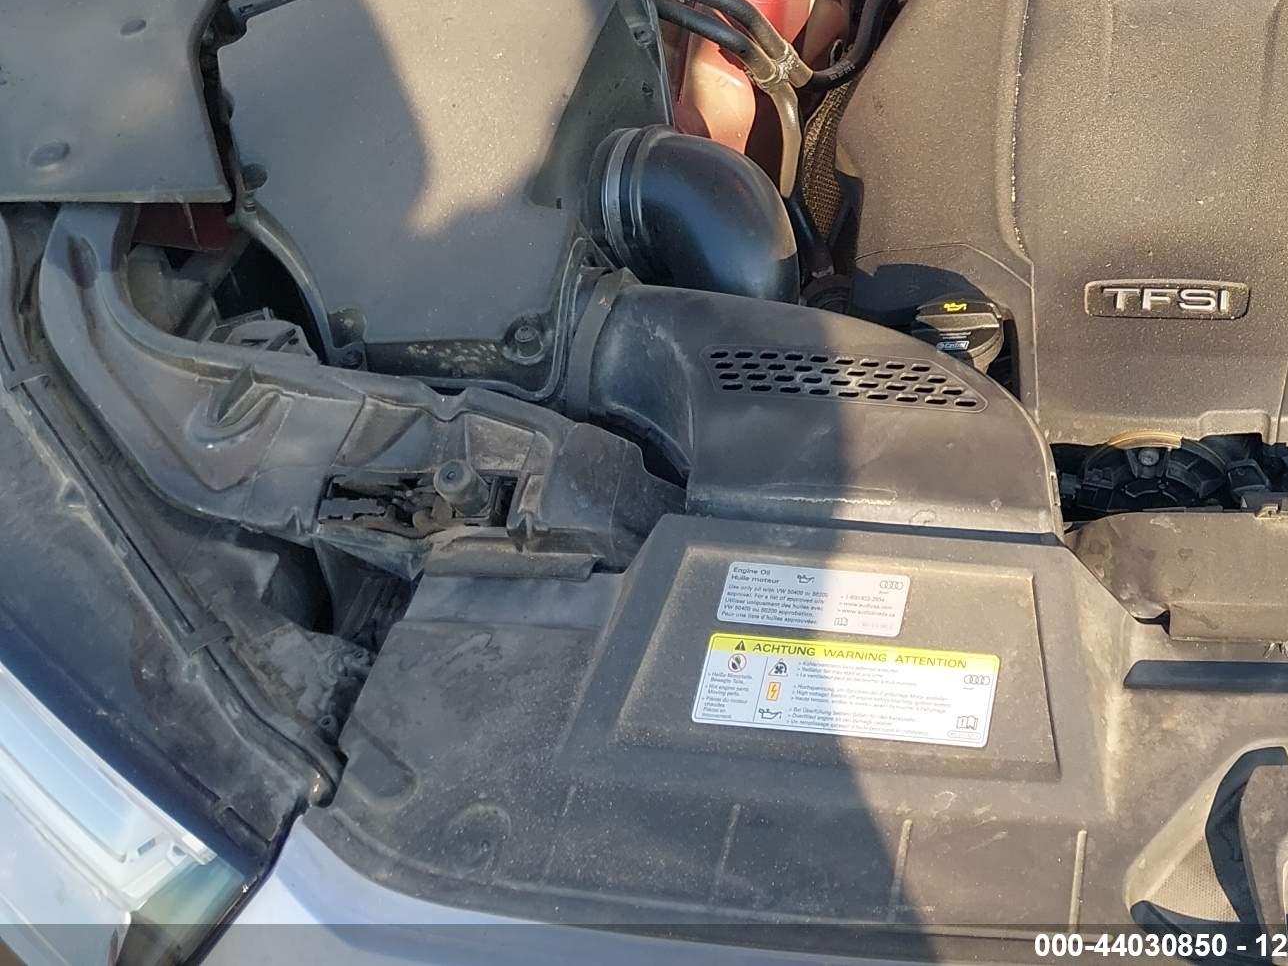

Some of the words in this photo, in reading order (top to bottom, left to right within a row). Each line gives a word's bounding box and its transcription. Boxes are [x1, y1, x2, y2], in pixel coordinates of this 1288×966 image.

[1102, 287, 1230, 314] TFSI
[733, 567, 758, 575] Engine
[752, 642, 816, 657] ACHTUNG
[823, 648, 888, 662] WARNING
[895, 653, 968, 669] ATTENTION
